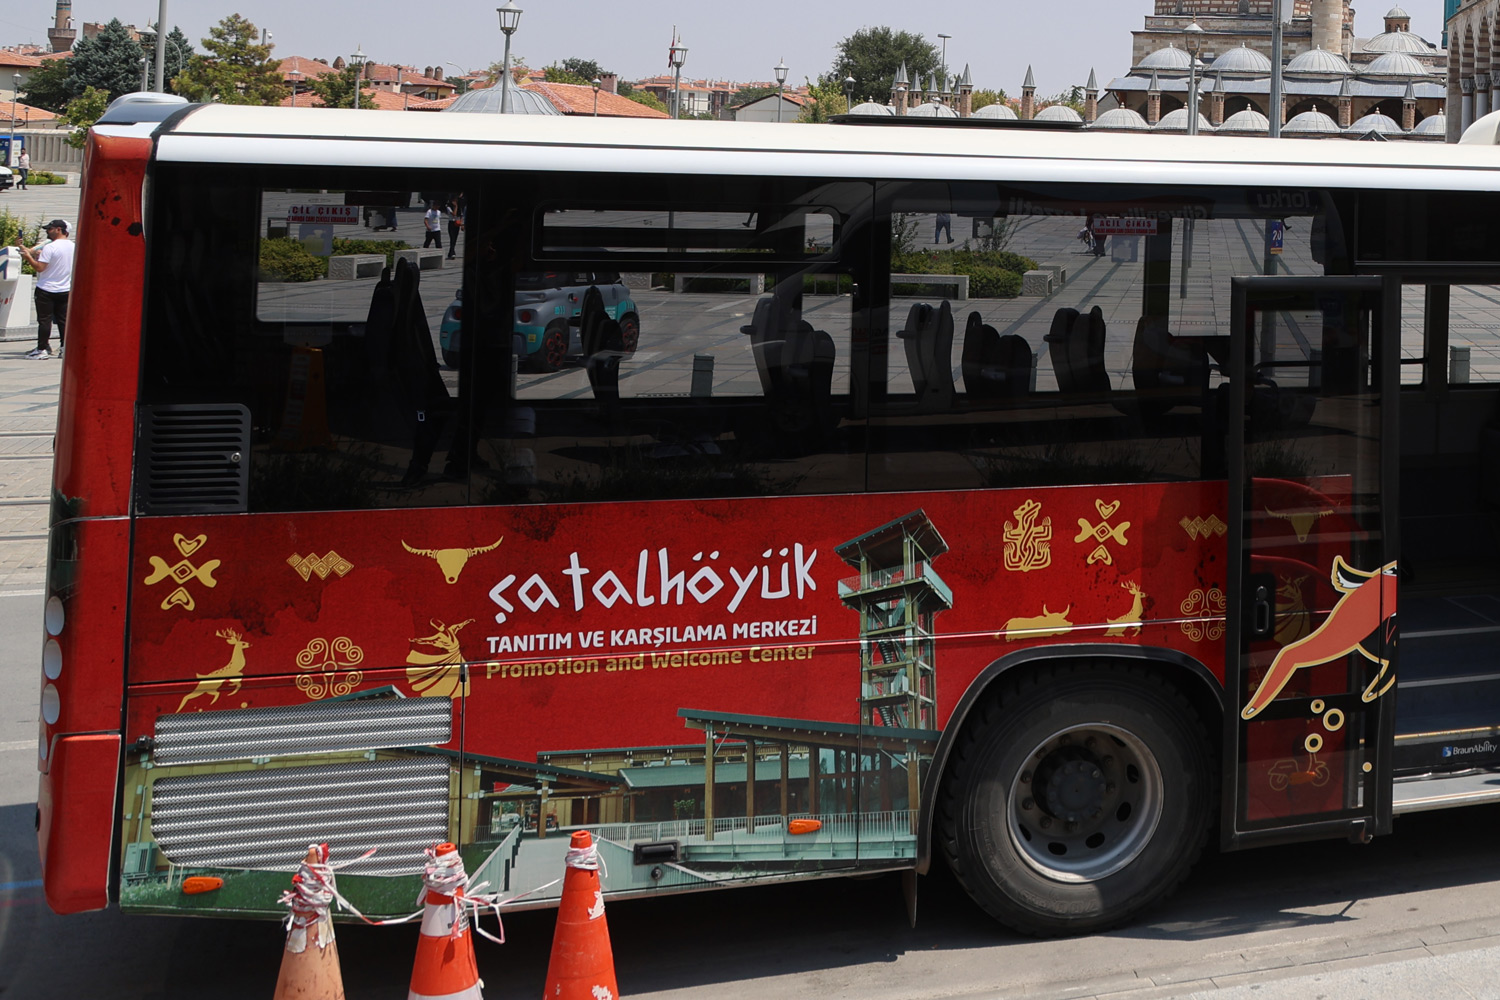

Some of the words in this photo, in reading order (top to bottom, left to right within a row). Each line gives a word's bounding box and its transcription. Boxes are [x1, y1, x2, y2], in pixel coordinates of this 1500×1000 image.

[488, 542, 817, 624] çatalhöyük
[486, 632, 572, 654] TANITIM
[578, 631, 605, 649] VE
[610, 623, 727, 648] KARŞILAMA
[732, 615, 817, 640] MERKEZİ
[486, 656, 599, 679] Promotion
[605, 652, 644, 673] and
[650, 648, 743, 669] Welcome
[748, 646, 815, 664] Center
[1453, 741, 1498, 755] BraunAbility
